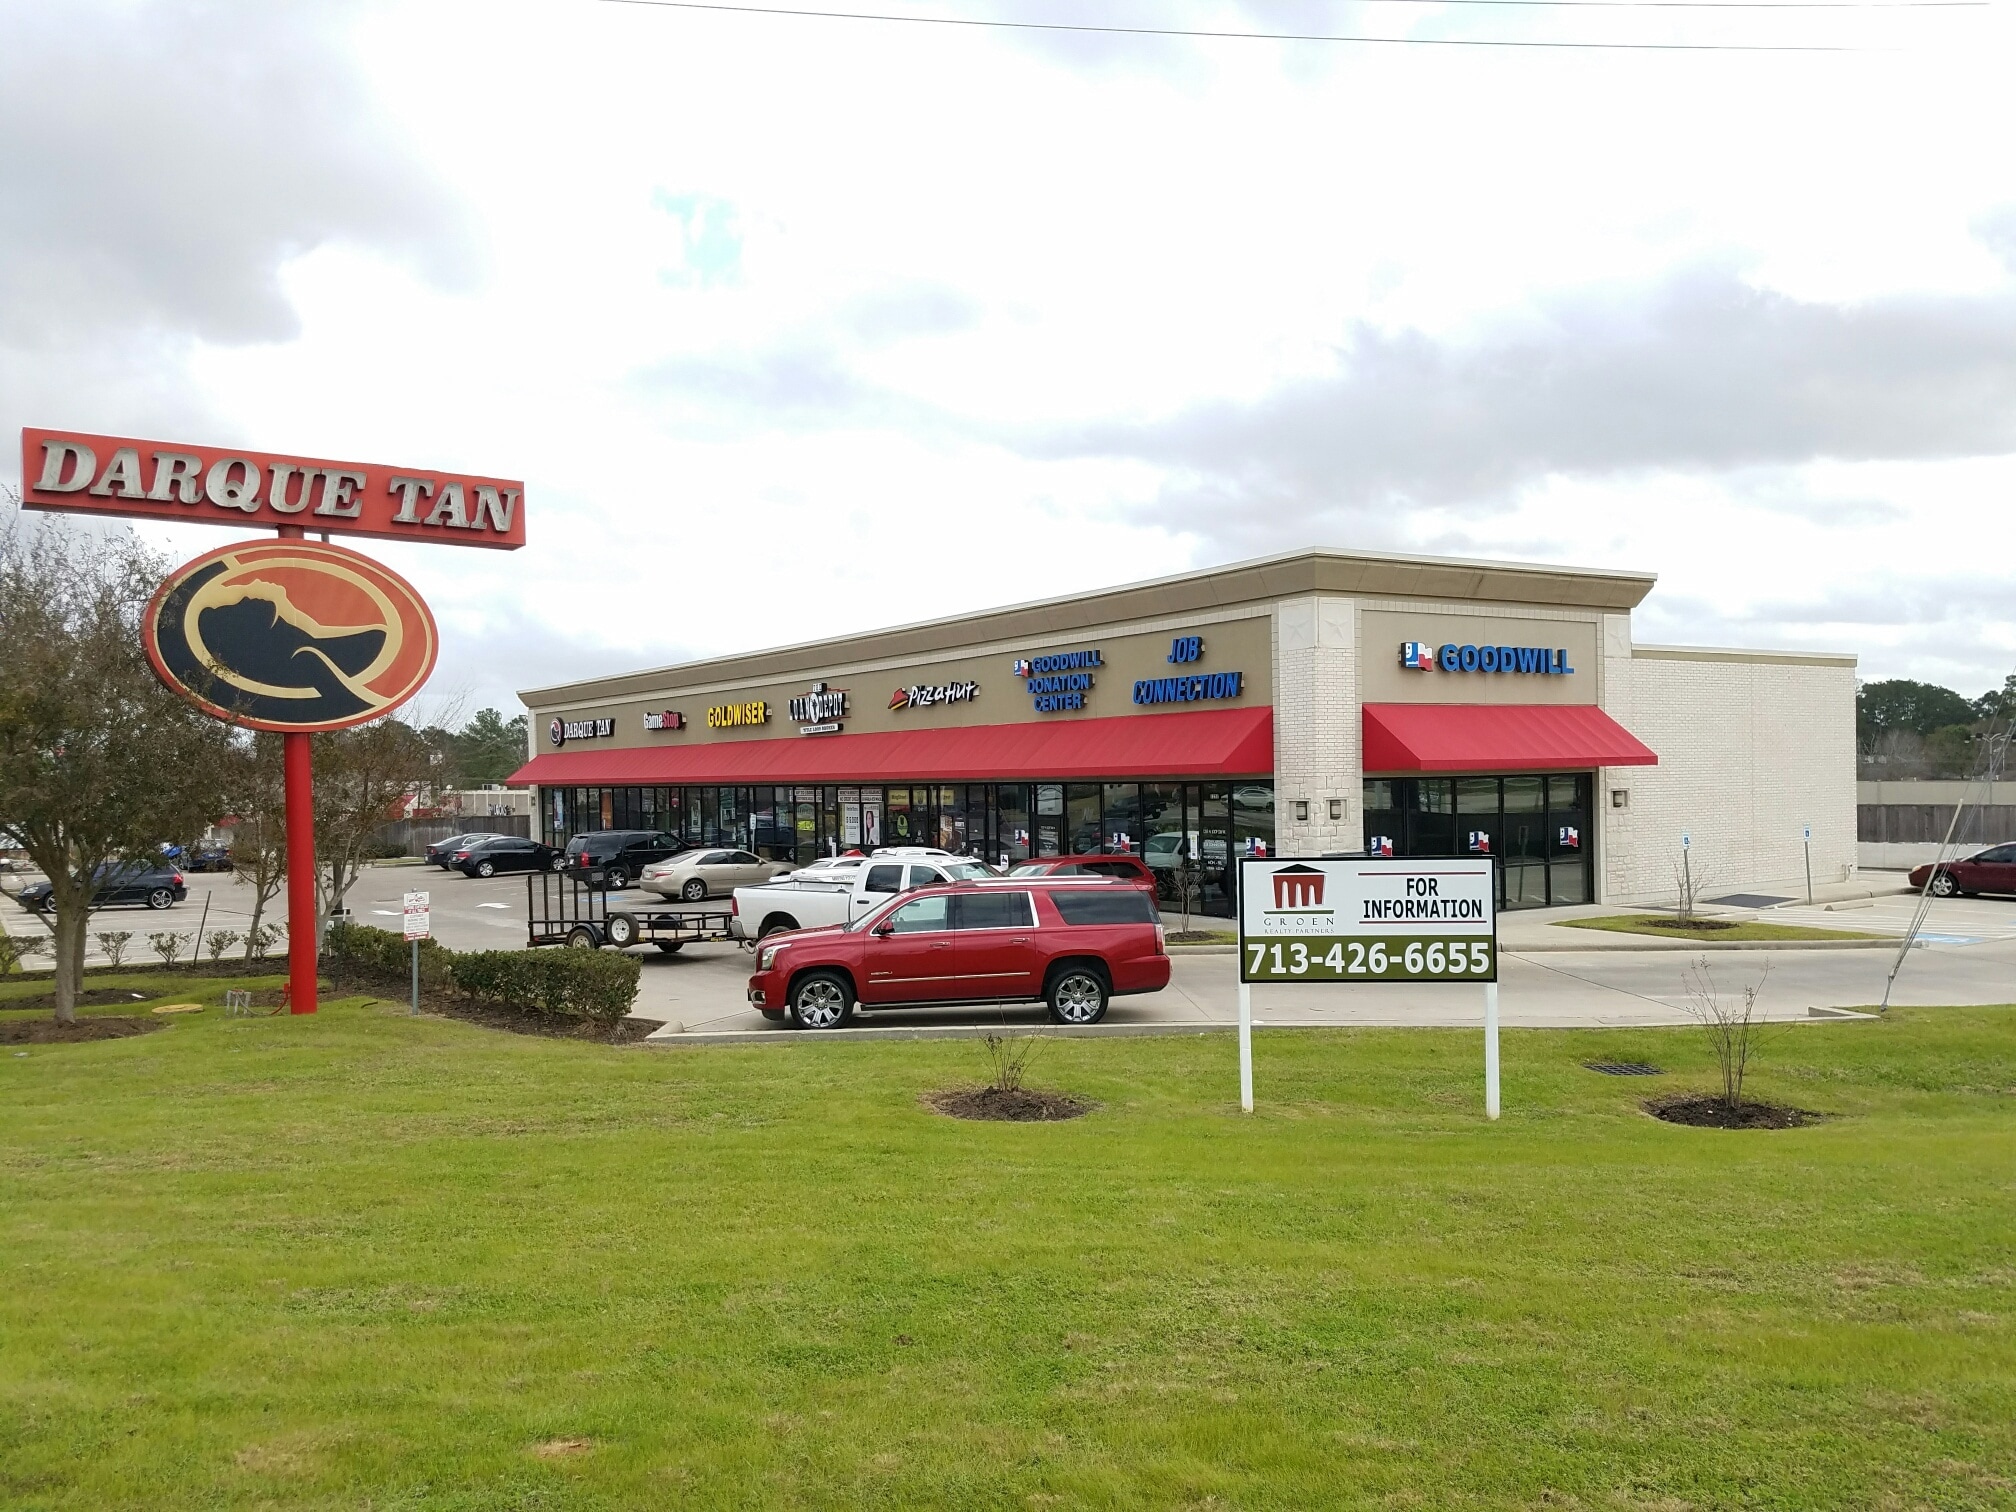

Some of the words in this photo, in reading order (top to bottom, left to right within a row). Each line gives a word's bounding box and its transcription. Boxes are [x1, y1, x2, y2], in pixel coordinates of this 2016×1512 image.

[32, 439, 367, 518] DARQUE
[389, 475, 522, 533] TAN
[1167, 636, 1202, 664] JOB
[1439, 643, 1575, 674] GOODWILL
[1032, 650, 1103, 673] GOODWILL
[945, 682, 975, 704] Hut
[1027, 674, 1091, 694] DONATION
[1133, 672, 1241, 705] CONNECTION
[788, 697, 810, 720] LOAN
[818, 693, 843, 718] DEPOT
[1034, 694, 1083, 712] CENTER
[643, 711, 680, 729] GameStop
[708, 701, 766, 728] GOLDWISER
[564, 720, 594, 739] DARQUE
[596, 719, 612, 736] TAN
[1406, 877, 1439, 897] FOR
[1363, 899, 1483, 919] INFORMATION
[1263, 917, 1335, 926] GROEN
[1247, 942, 1490, 975] 713-426-6655
